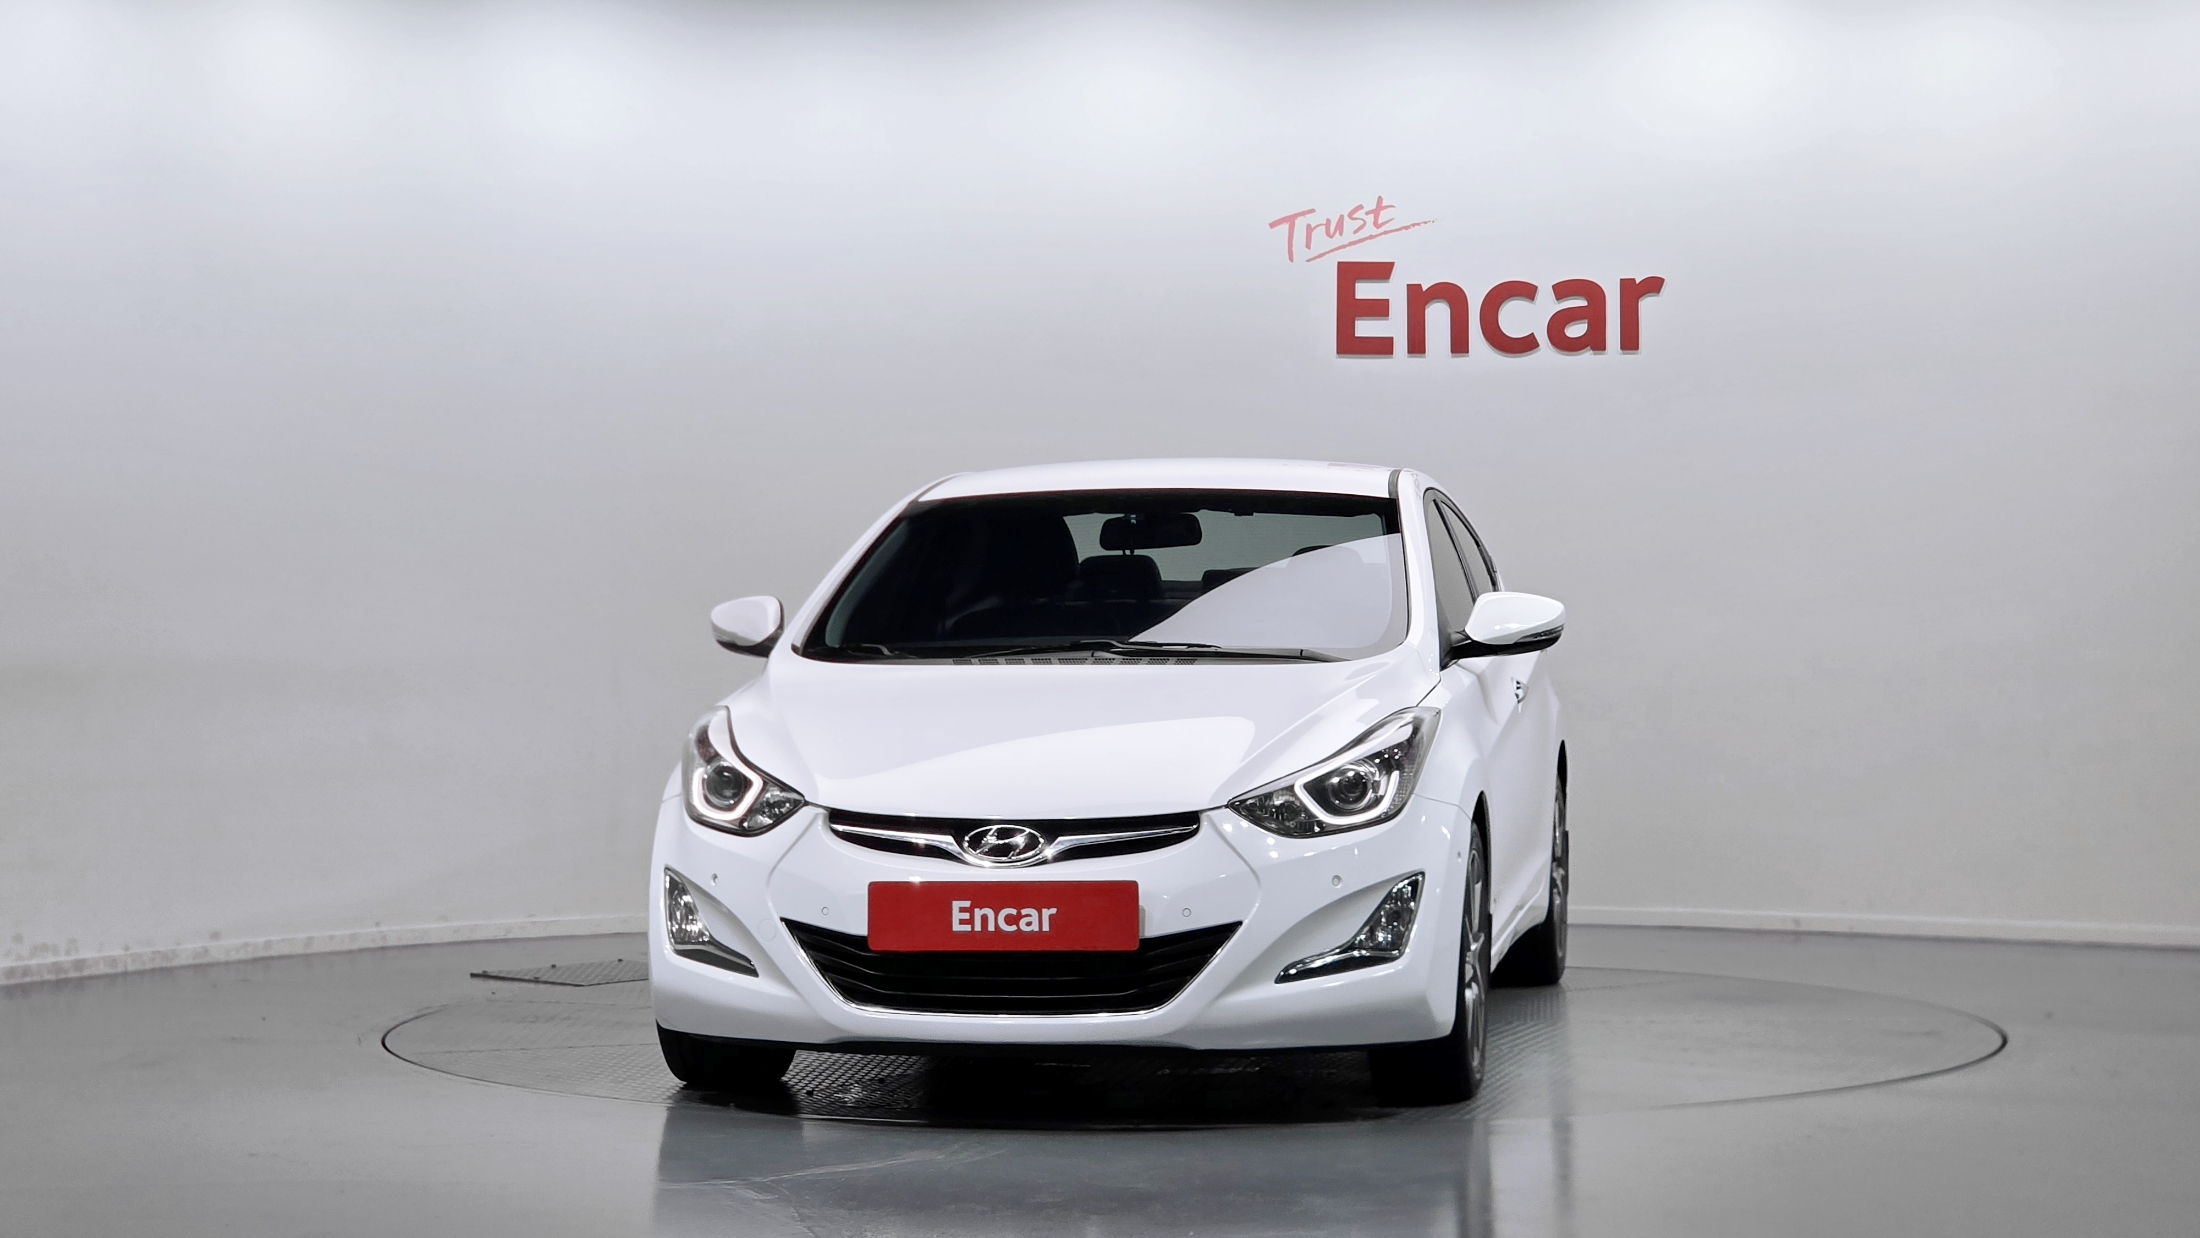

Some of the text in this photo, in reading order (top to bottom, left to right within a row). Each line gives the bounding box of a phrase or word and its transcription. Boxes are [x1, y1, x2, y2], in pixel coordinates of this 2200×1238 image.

[1269, 195, 1396, 262] Trust
[1336, 261, 1666, 356] Encar
[951, 900, 1057, 932] Encar
